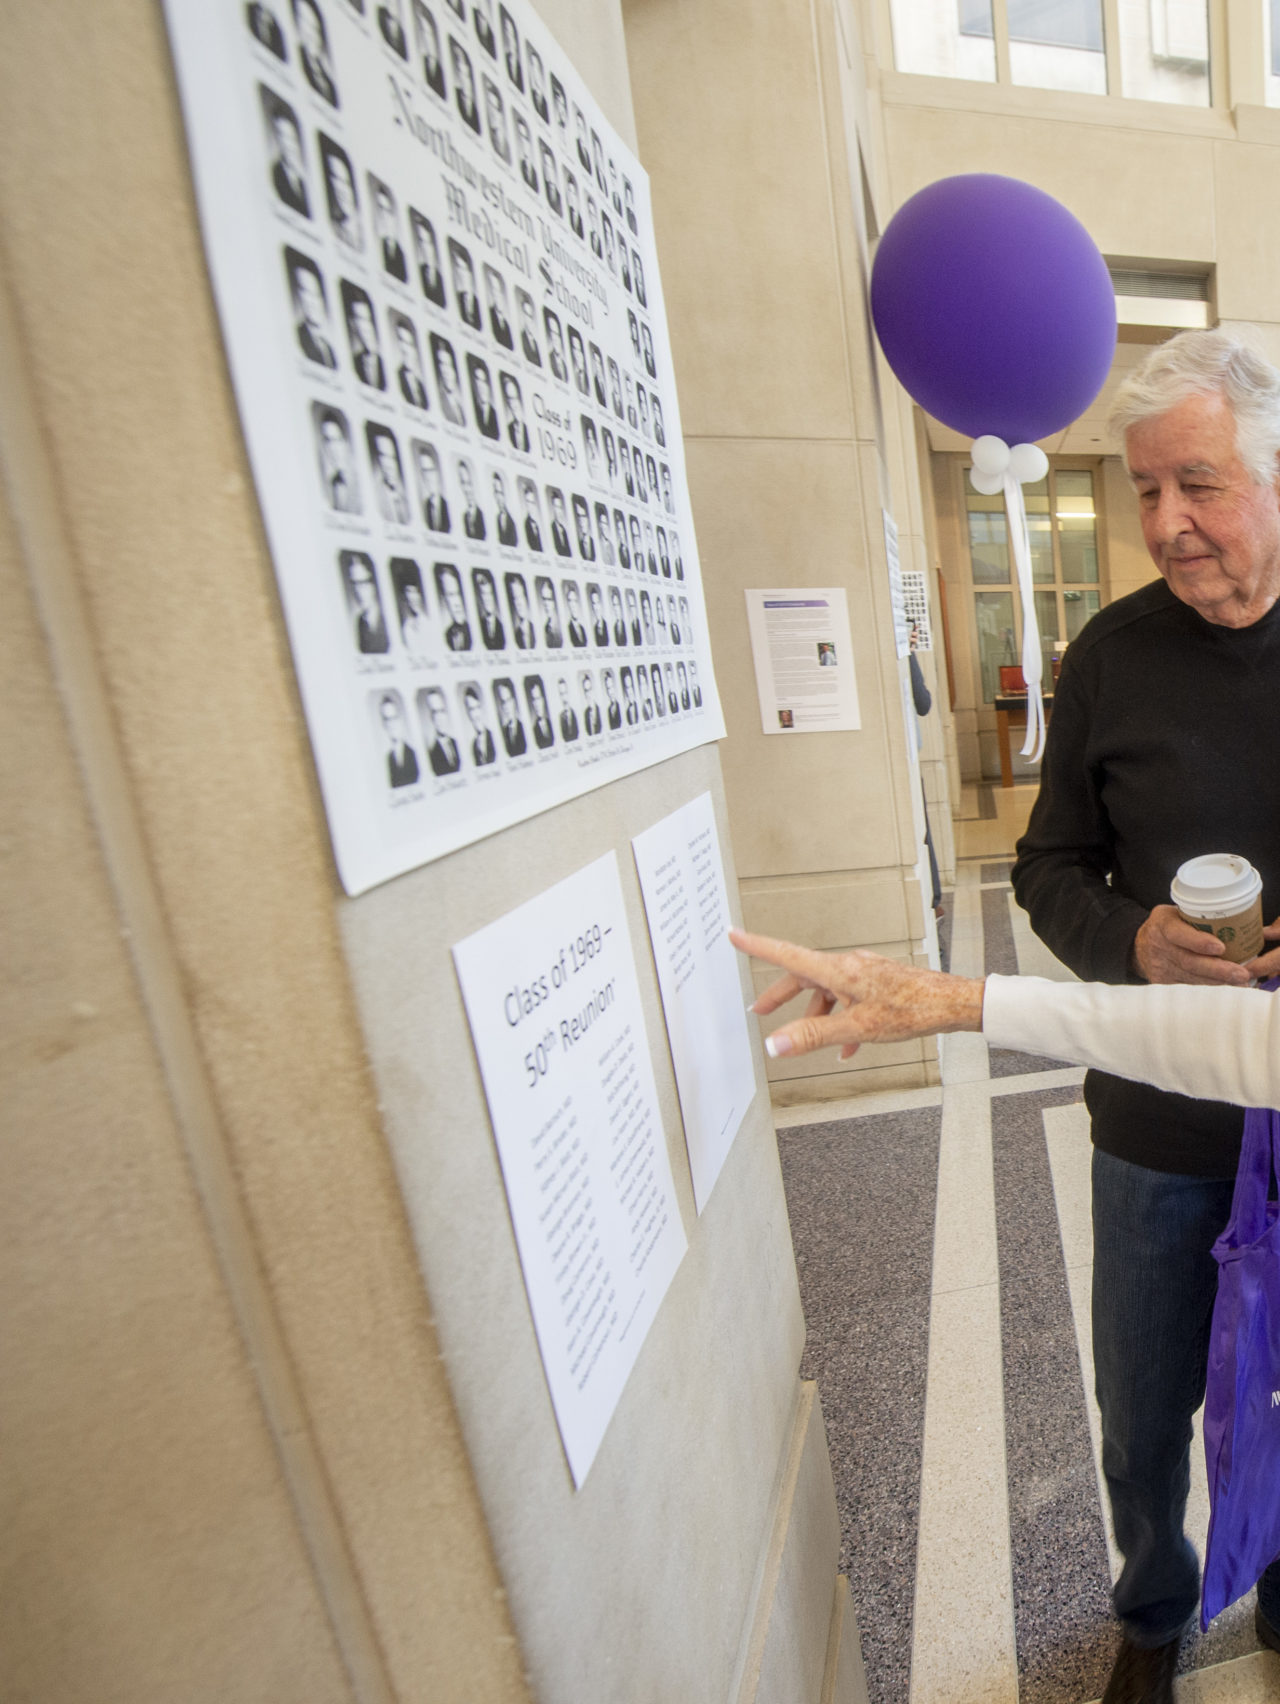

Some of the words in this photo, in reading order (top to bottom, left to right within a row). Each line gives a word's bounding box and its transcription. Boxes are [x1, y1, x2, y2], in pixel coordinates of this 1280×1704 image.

[387, 73, 536, 241] Northwestern
[537, 215, 609, 316] University
[440, 172, 531, 279] Medical
[538, 256, 595, 330] School
[532, 392, 562, 428] Class
[563, 409, 572, 432] of
[537, 426, 577, 470] 1969
[503, 984, 549, 1027] Class
[551, 949, 568, 989] of
[569, 924, 602, 974] 1969
[524, 1027, 557, 1088] 50th
